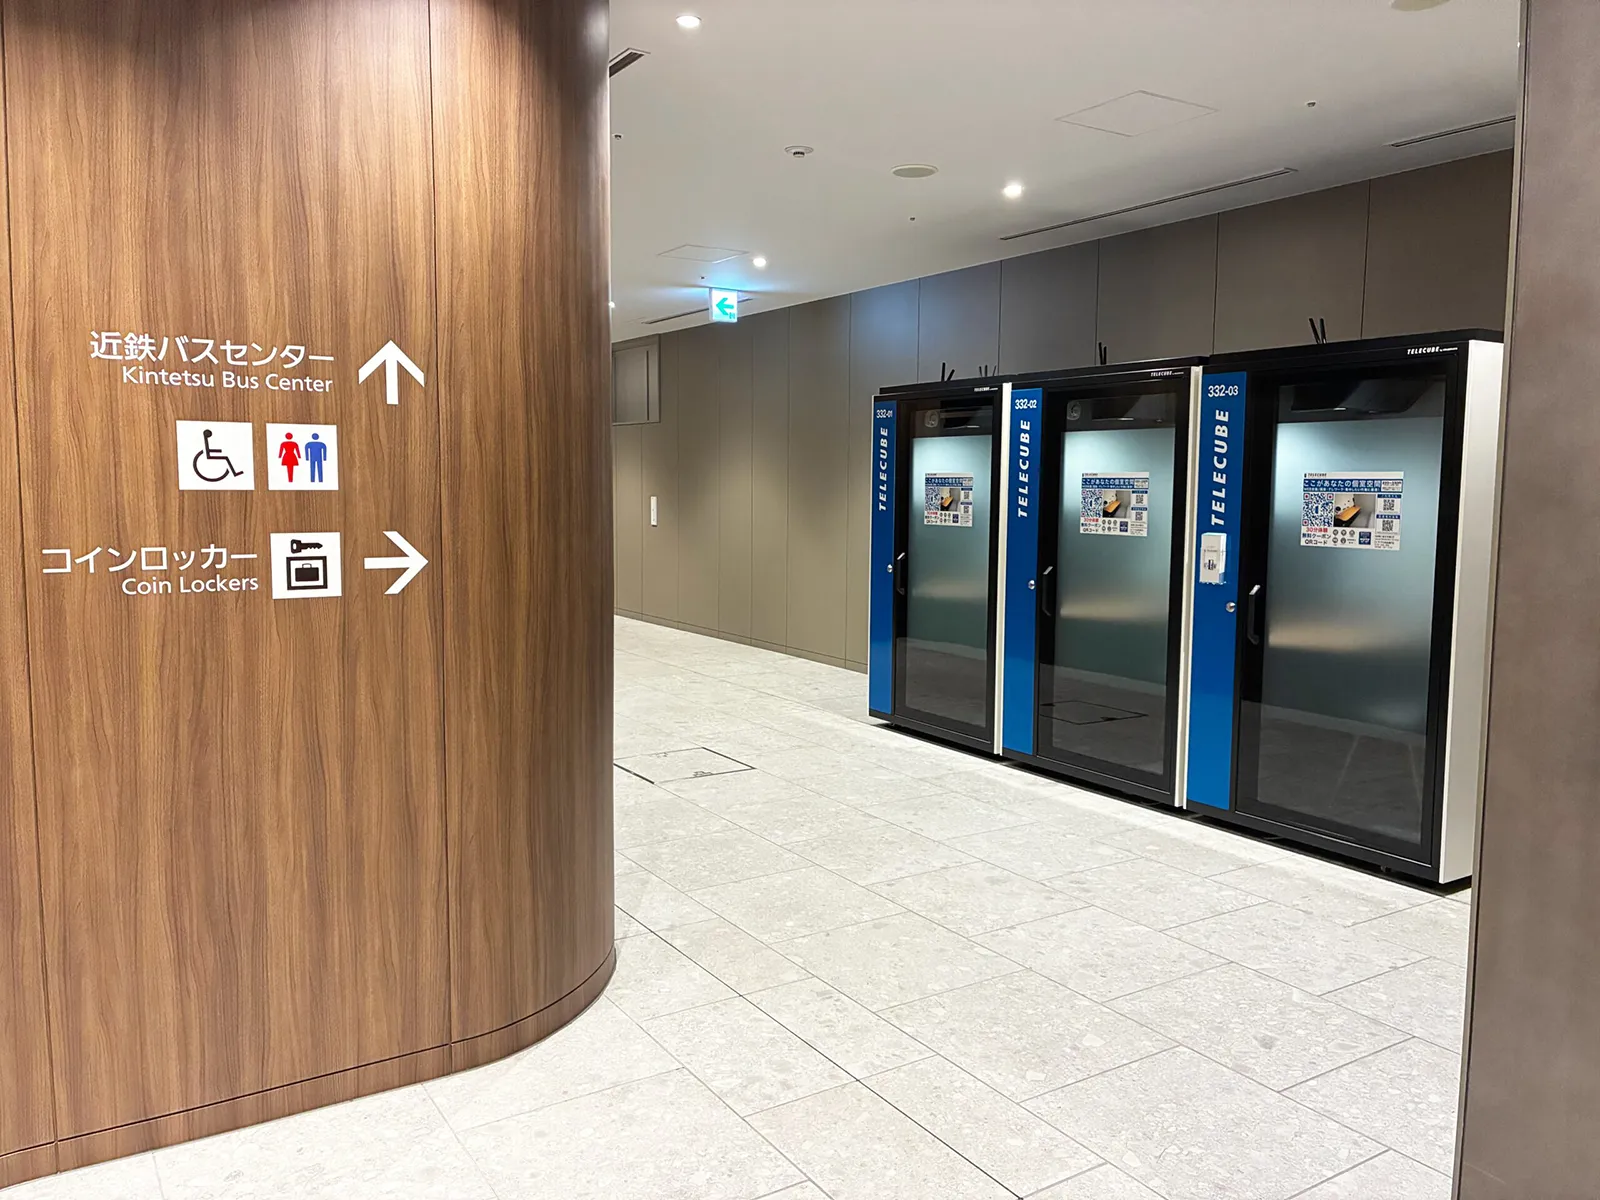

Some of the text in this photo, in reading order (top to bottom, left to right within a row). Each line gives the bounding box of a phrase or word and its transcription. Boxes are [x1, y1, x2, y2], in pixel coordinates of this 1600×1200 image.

[90, 331, 334, 368] 近鉄バスセンター
[1407, 346, 1440, 355] TELECUBE
[122, 365, 333, 393] Kintetsu Bus Center
[1207, 384, 1239, 397] 332-03
[876, 409, 893, 419] 332-01
[1014, 398, 1037, 409] 332-02
[878, 427, 889, 511] TELECUBE
[1018, 419, 1031, 518] TELECUBE
[1211, 409, 1229, 526] TELECUBE
[42, 543, 258, 574] コインロッカー
[122, 575, 259, 595] Coin Lockers
